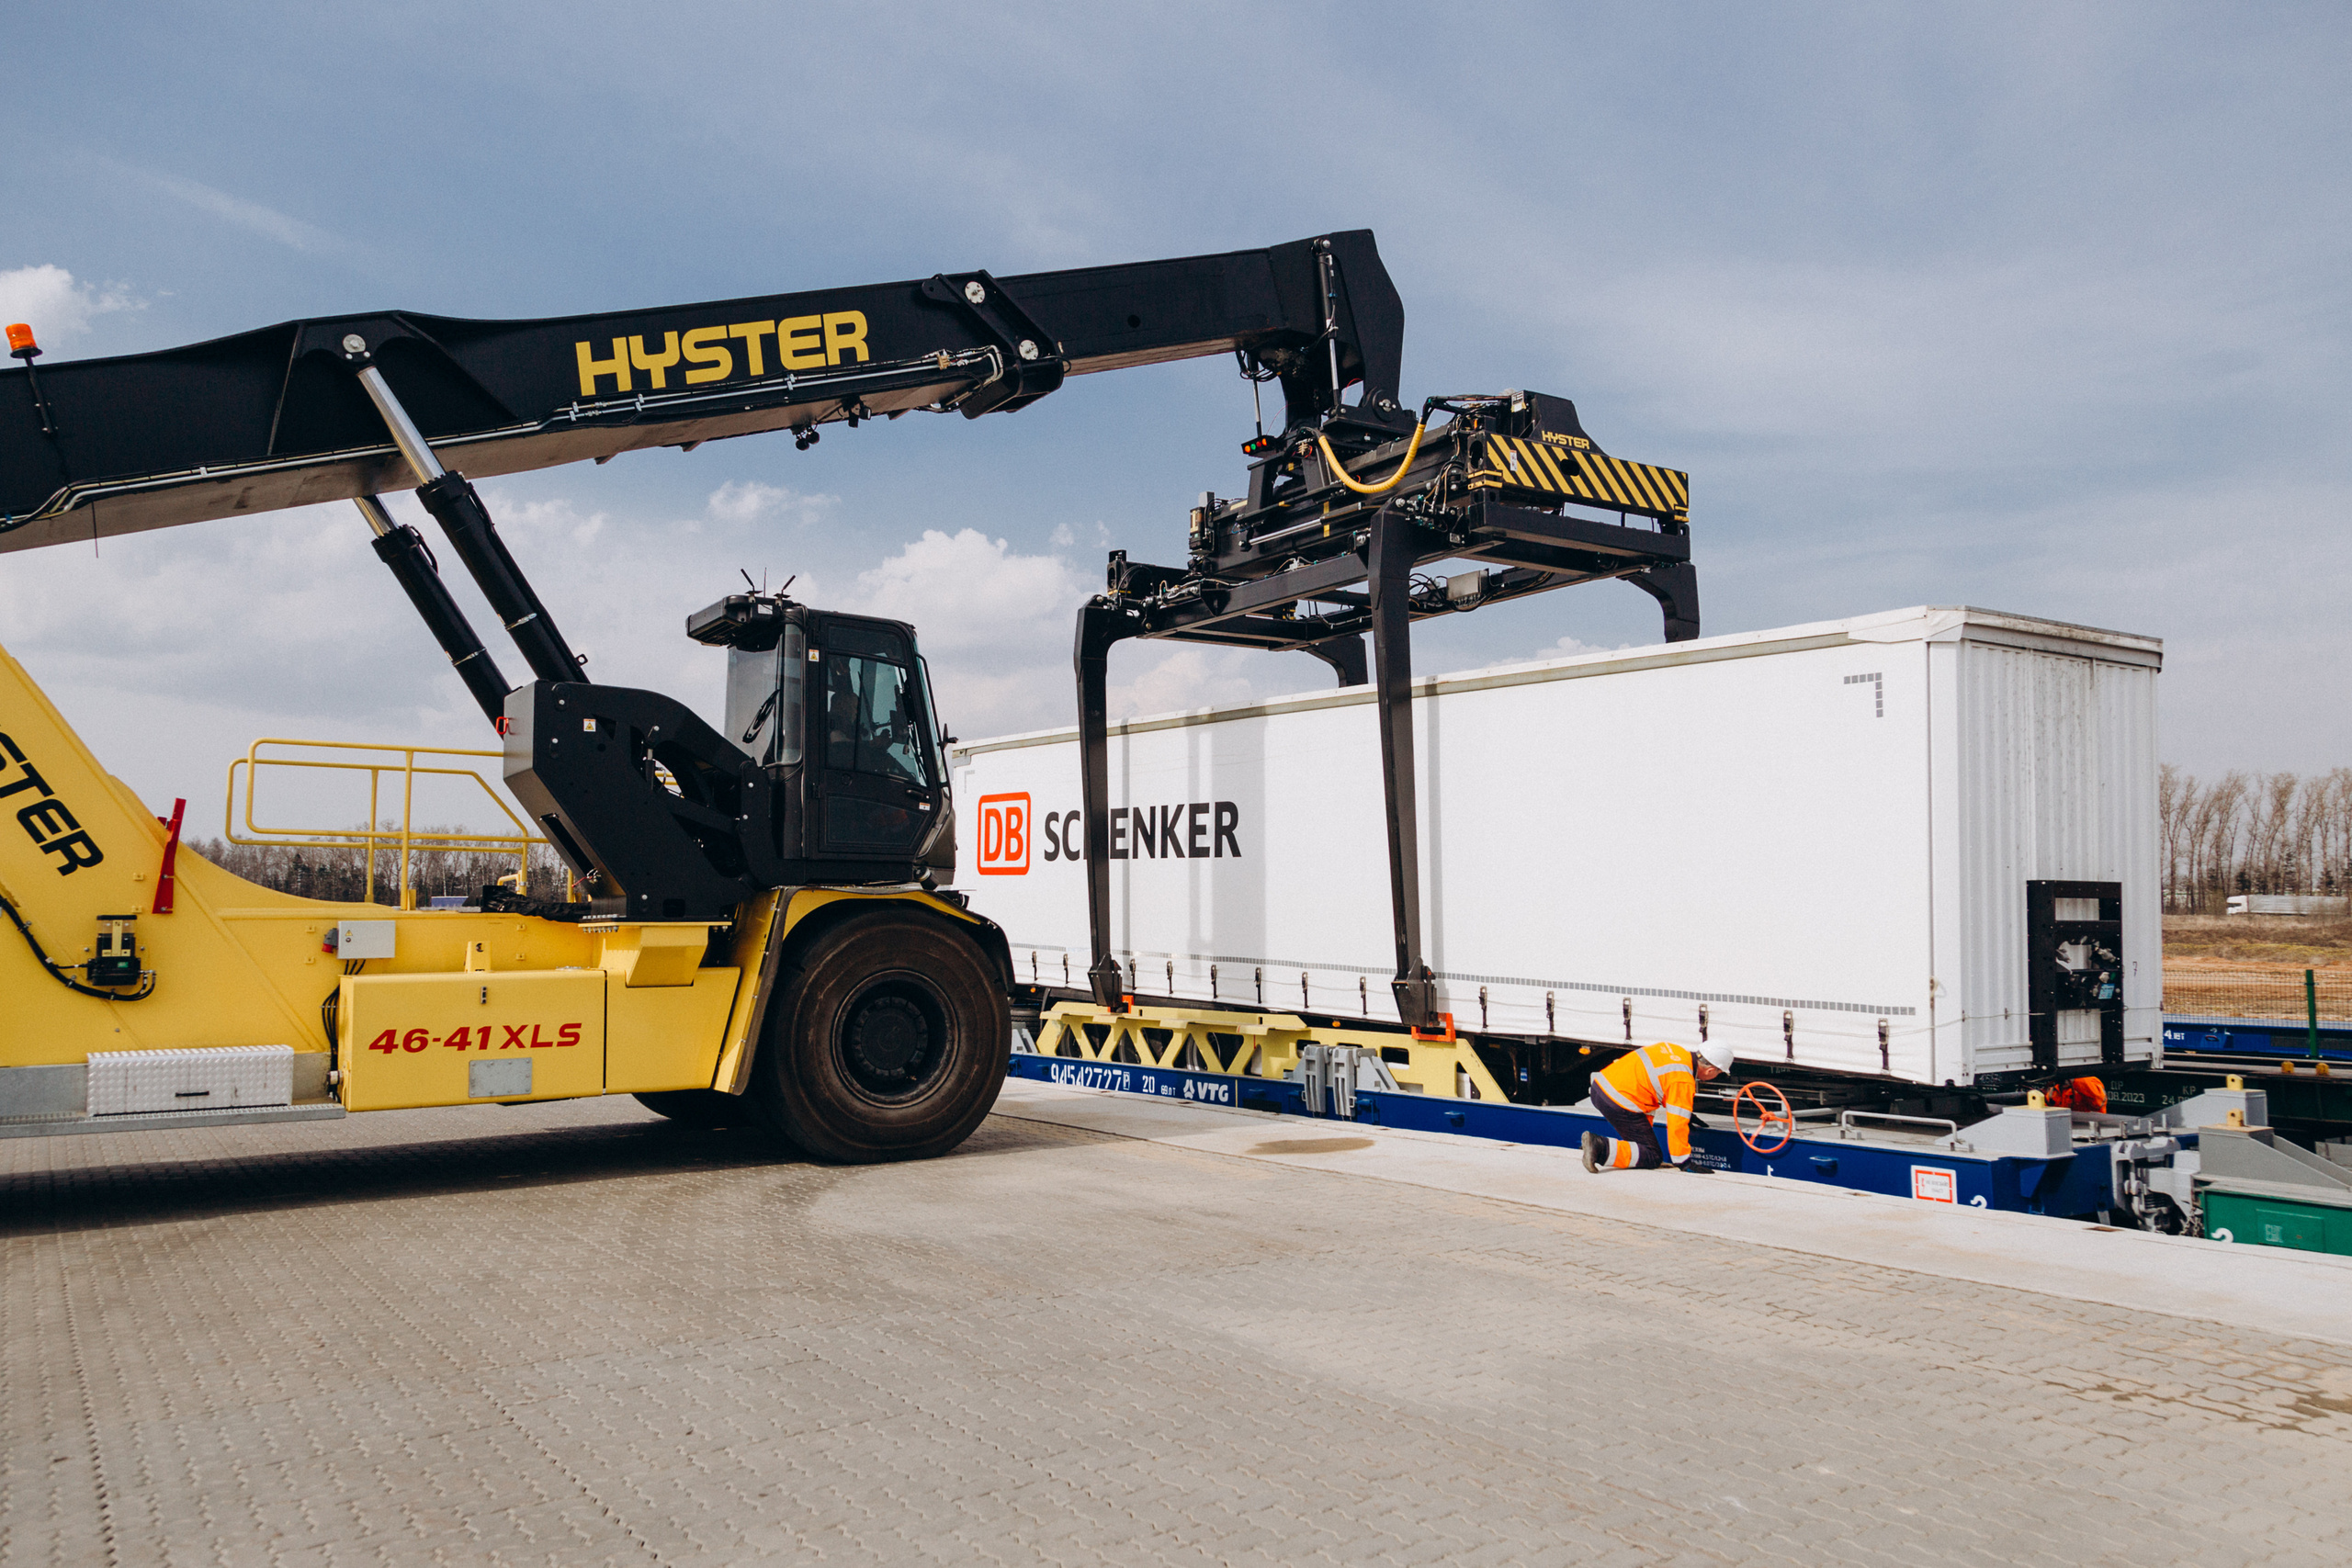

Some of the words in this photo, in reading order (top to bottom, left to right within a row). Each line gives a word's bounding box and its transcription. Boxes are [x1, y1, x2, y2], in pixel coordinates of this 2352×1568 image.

[575, 310, 869, 396] HYSTER
[1542, 430, 1589, 450] HYSTER
[0, 732, 104, 876] STER
[984, 807, 1023, 862] DB
[1044, 801, 1242, 862] SCENKER
[368, 1026, 492, 1055] 46-41
[499, 1022, 582, 1050] XLS
[1142, 1075, 1156, 1093] 20
[1197, 1082, 1228, 1102] VTG
[2107, 1091, 2145, 1102] 08.2023
